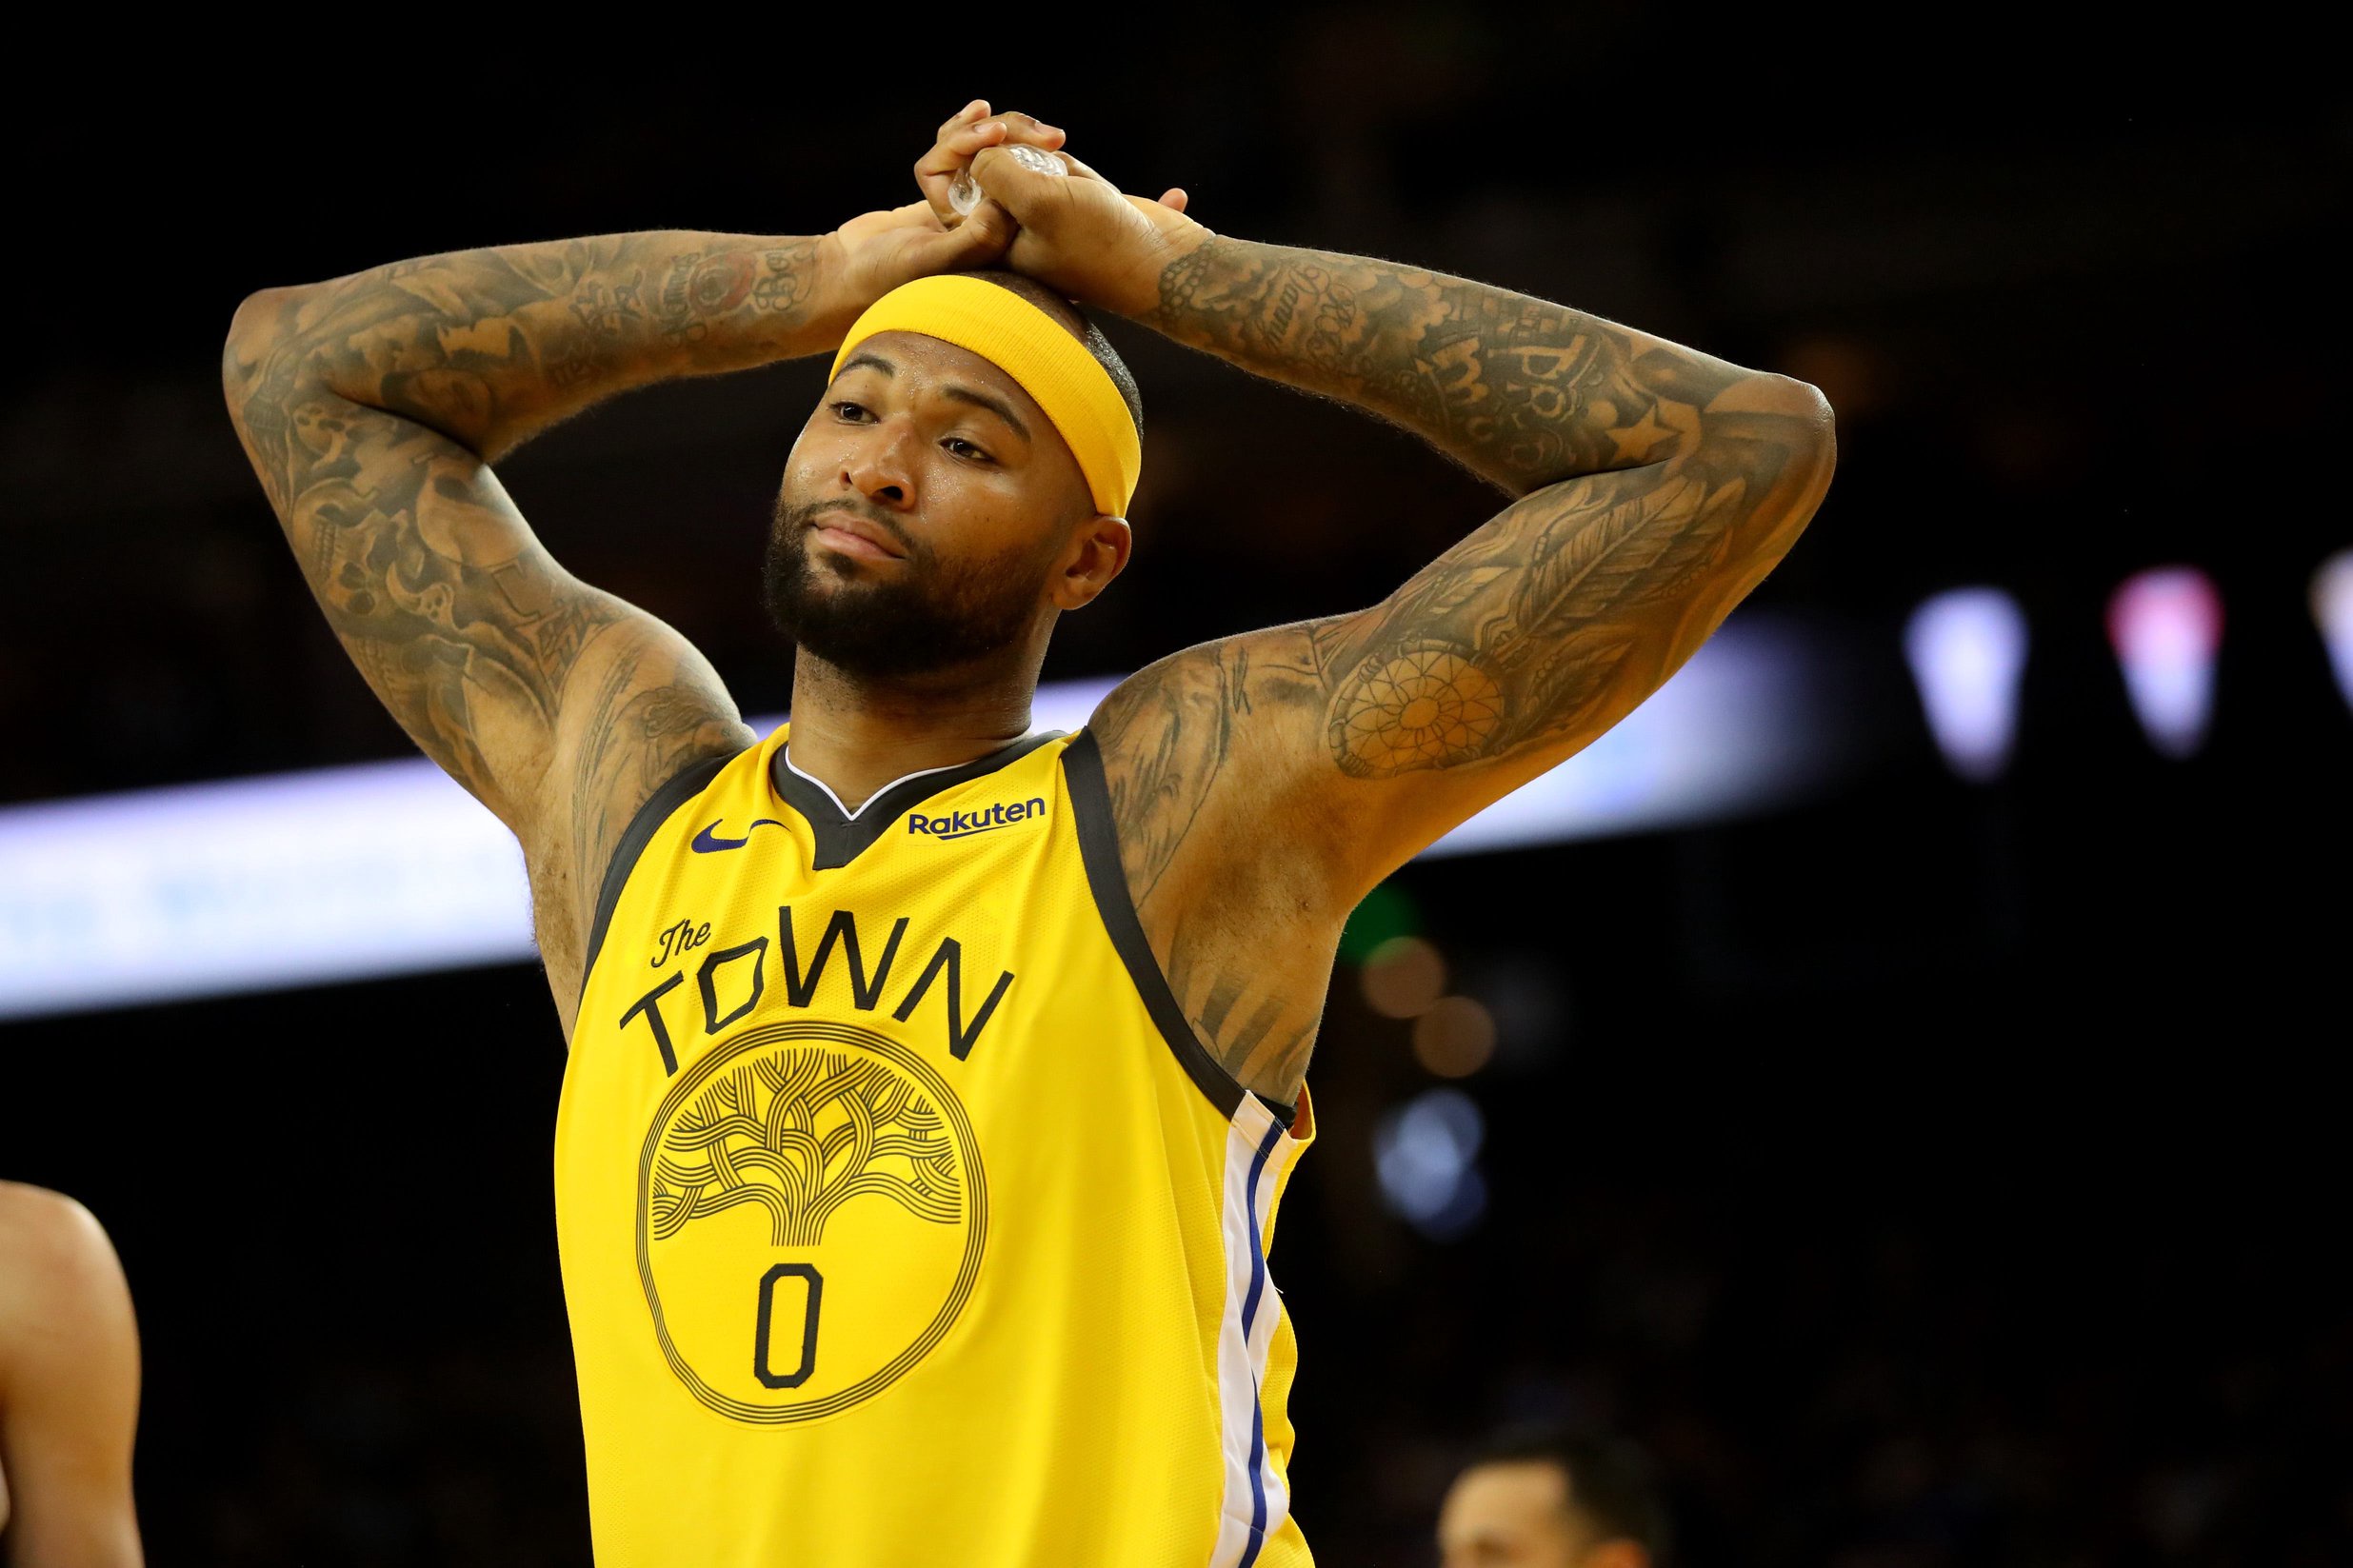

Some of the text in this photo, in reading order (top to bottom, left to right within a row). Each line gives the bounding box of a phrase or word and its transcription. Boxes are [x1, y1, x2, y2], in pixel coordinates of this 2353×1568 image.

[908, 797, 1046, 836] Rakuten
[650, 919, 711, 968] The
[620, 905, 1015, 1078] TOWN
[754, 1262, 824, 1390] 0
